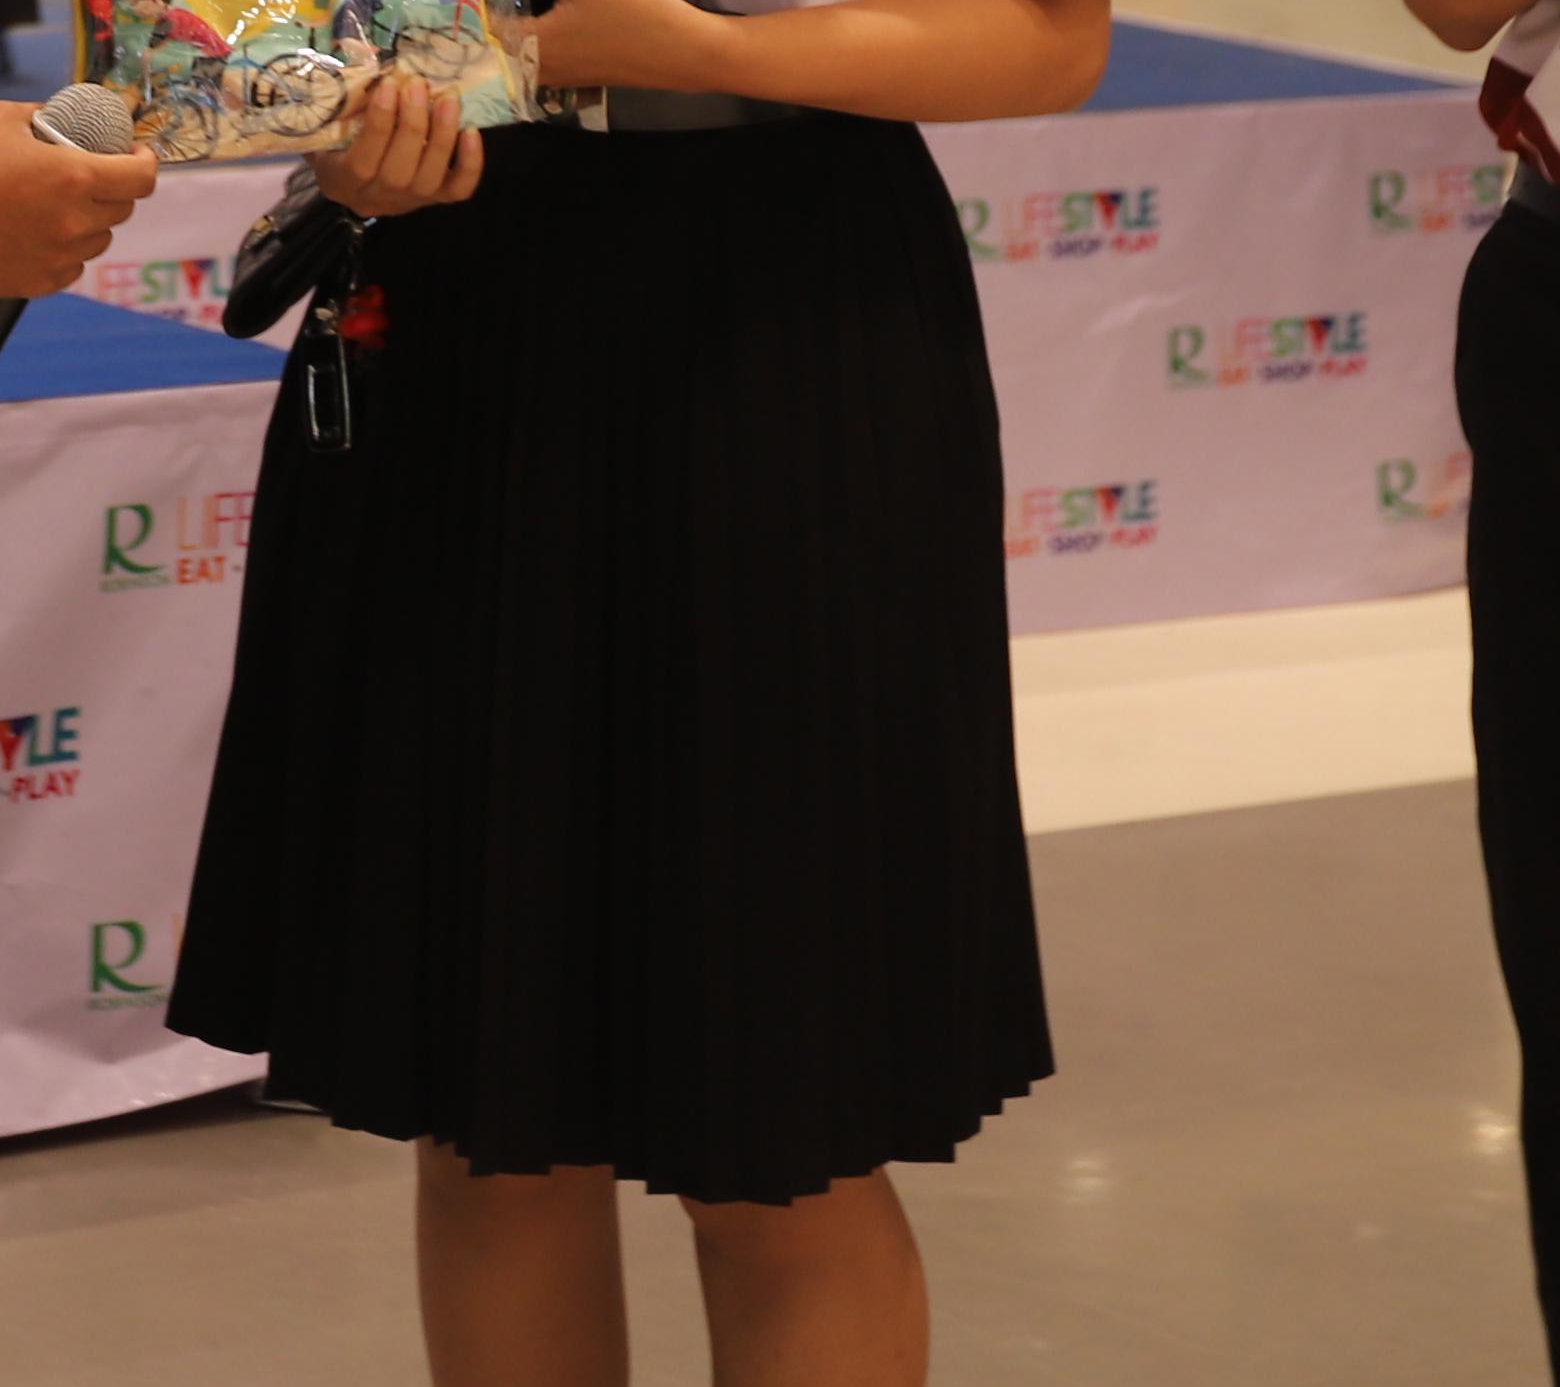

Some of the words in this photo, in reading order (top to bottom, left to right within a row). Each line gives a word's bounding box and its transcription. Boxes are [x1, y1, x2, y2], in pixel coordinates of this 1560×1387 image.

[102, 503, 168, 575] R
[176, 555, 226, 586] EAT
[12, 769, 81, 805] PLAY
[90, 920, 167, 993] R
